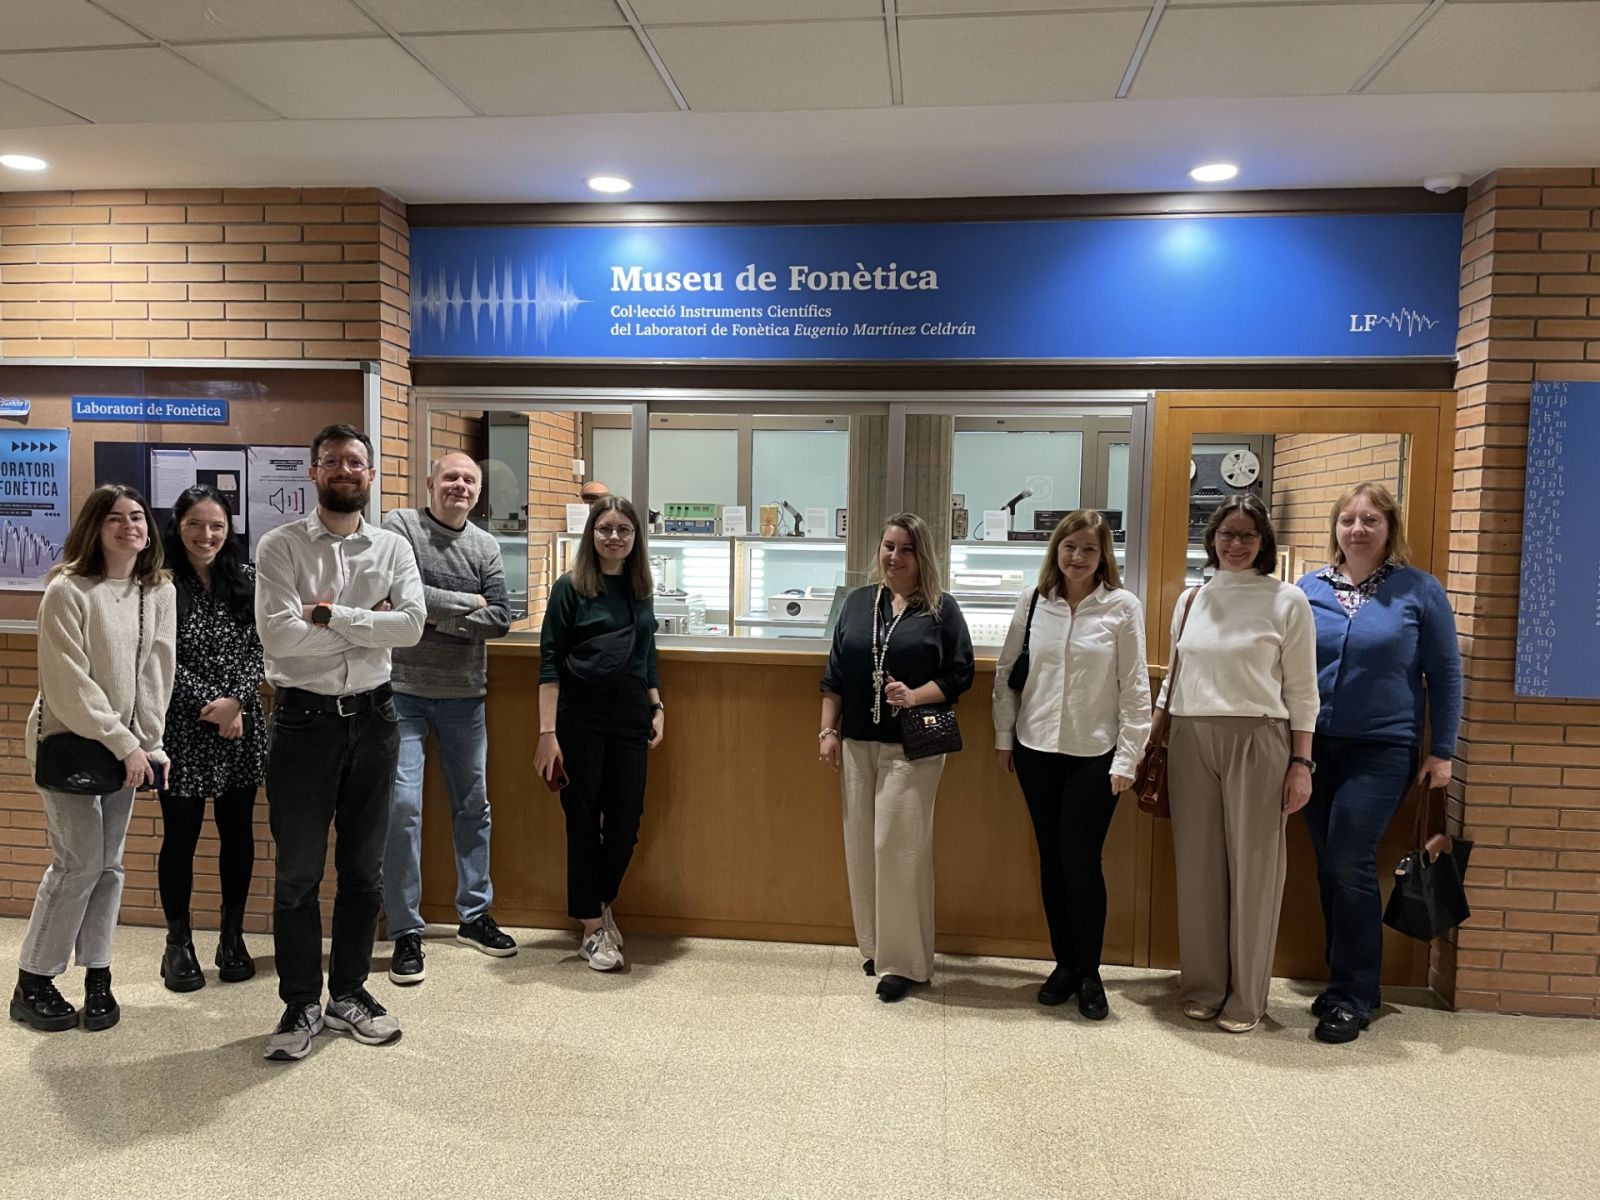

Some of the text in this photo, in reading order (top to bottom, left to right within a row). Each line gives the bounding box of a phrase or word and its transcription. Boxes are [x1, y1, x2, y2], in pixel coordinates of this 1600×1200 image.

[610, 262, 939, 292] Museu de Fonètica
[610, 304, 832, 318] Col·lecció Instruments Científics
[610, 320, 976, 339] del Laboratori de Fonètica Eugenio Martínez Celdrán
[1349, 314, 1377, 332] LF
[76, 402, 222, 417] Laboratori de Fonètica
[1, 461, 55, 478] ORATORI
